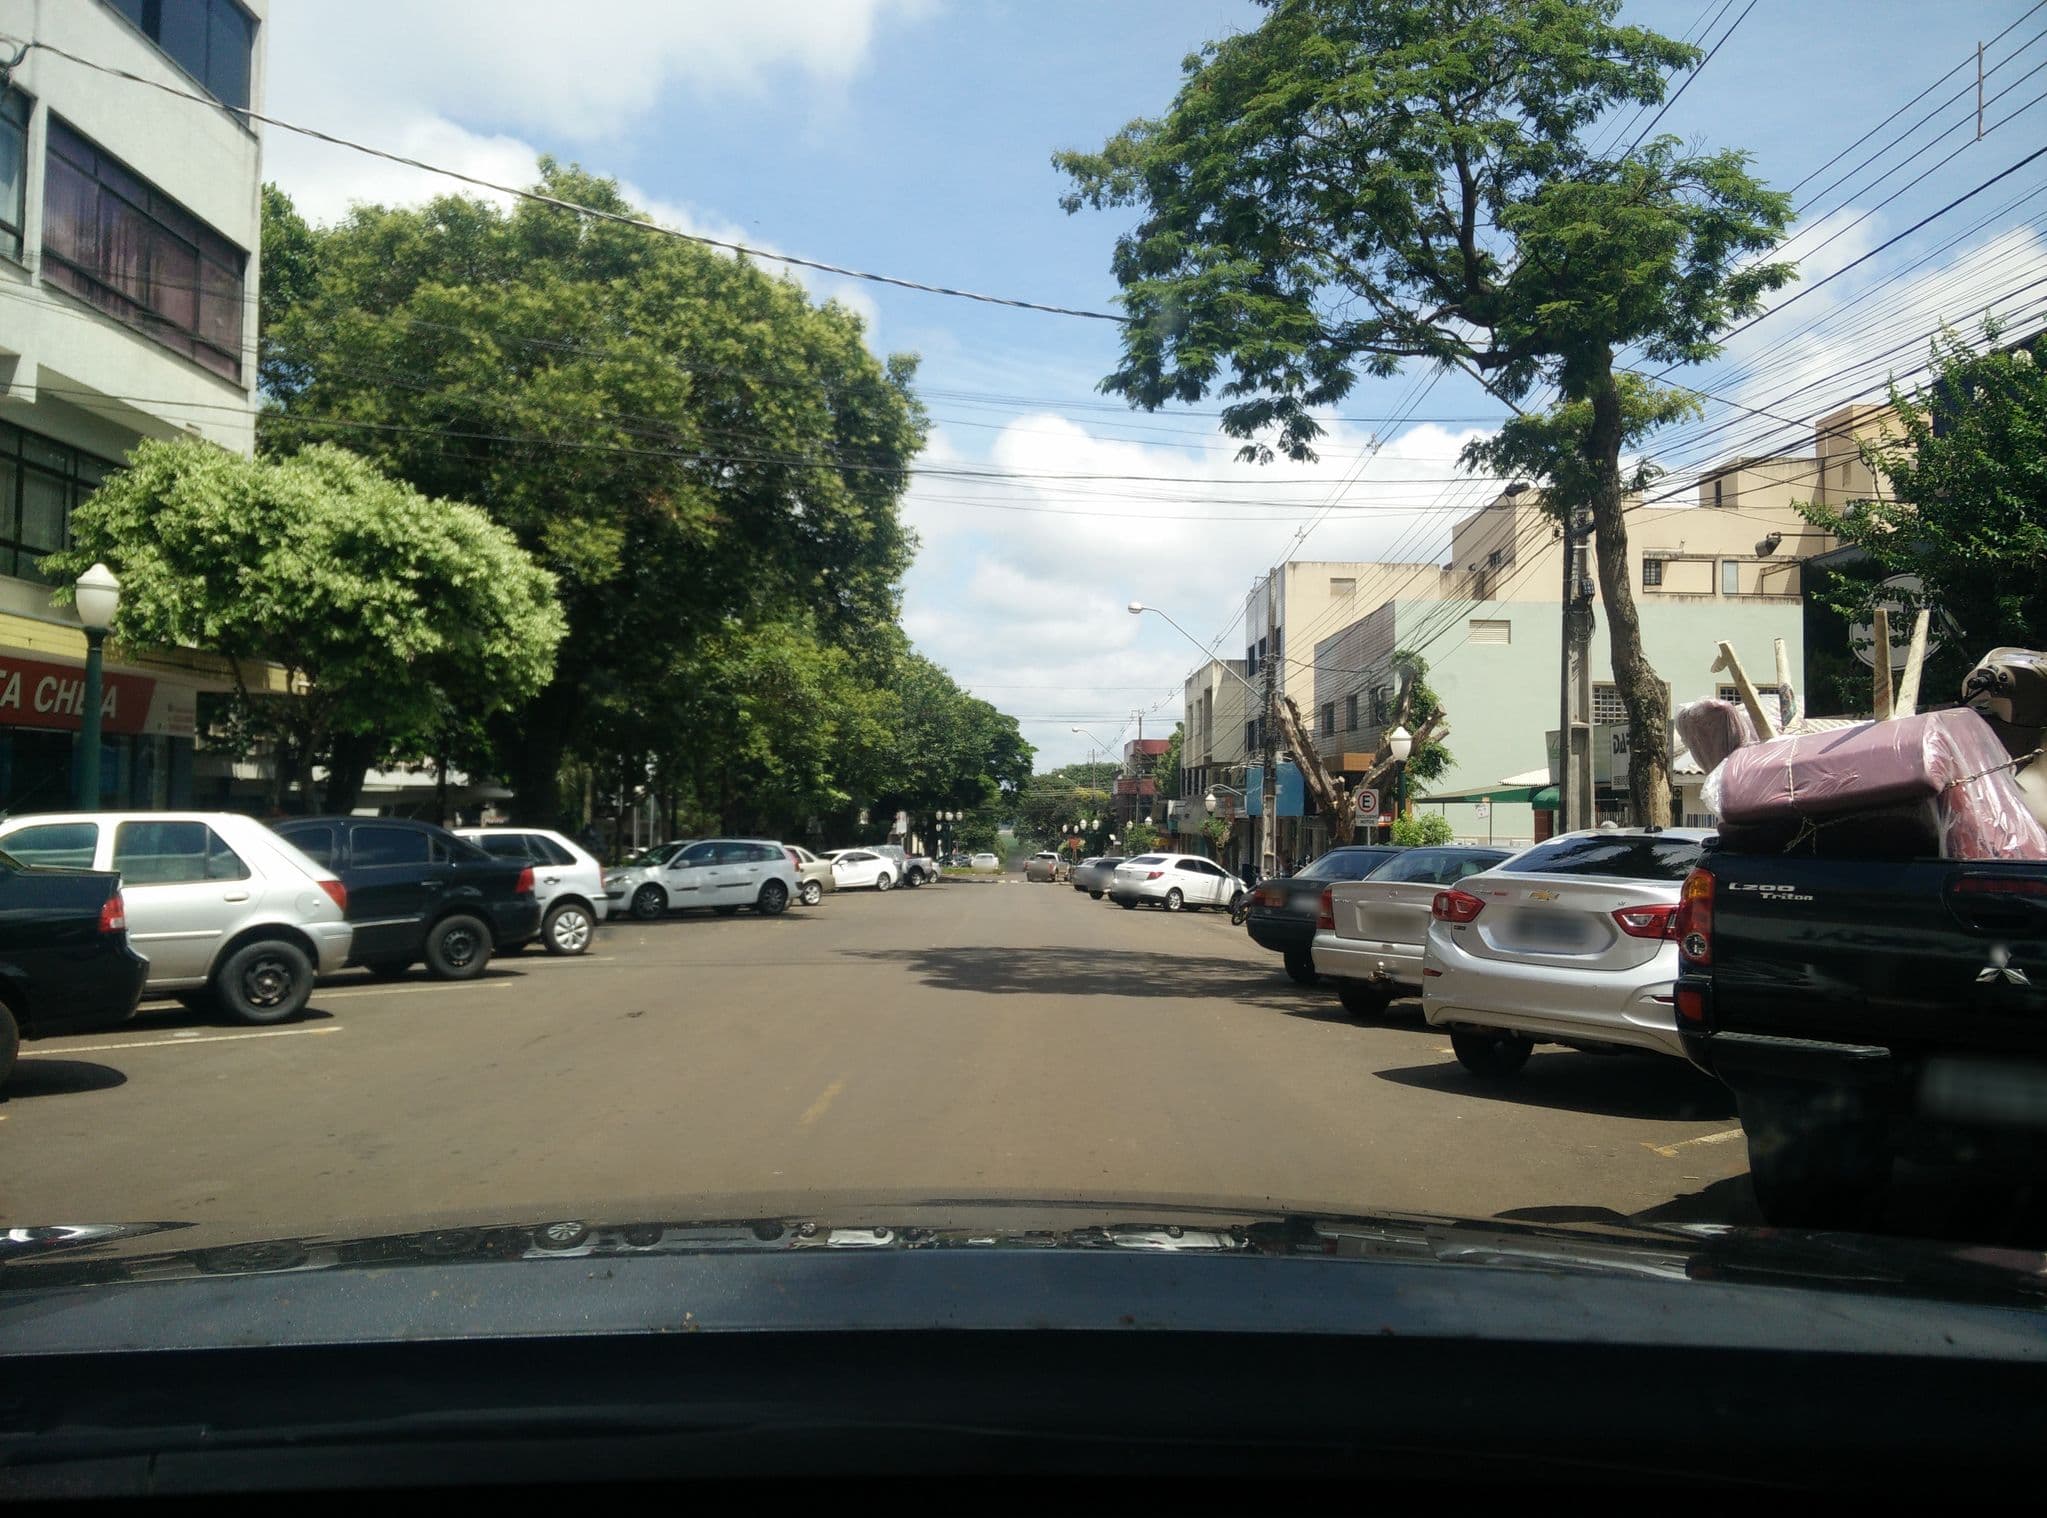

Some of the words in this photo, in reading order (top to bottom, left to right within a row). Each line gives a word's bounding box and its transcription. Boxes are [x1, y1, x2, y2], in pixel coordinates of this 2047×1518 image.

[1362, 795, 1371, 808] E
[1728, 881, 1796, 892] L200
[1759, 892, 1814, 901] Triton
